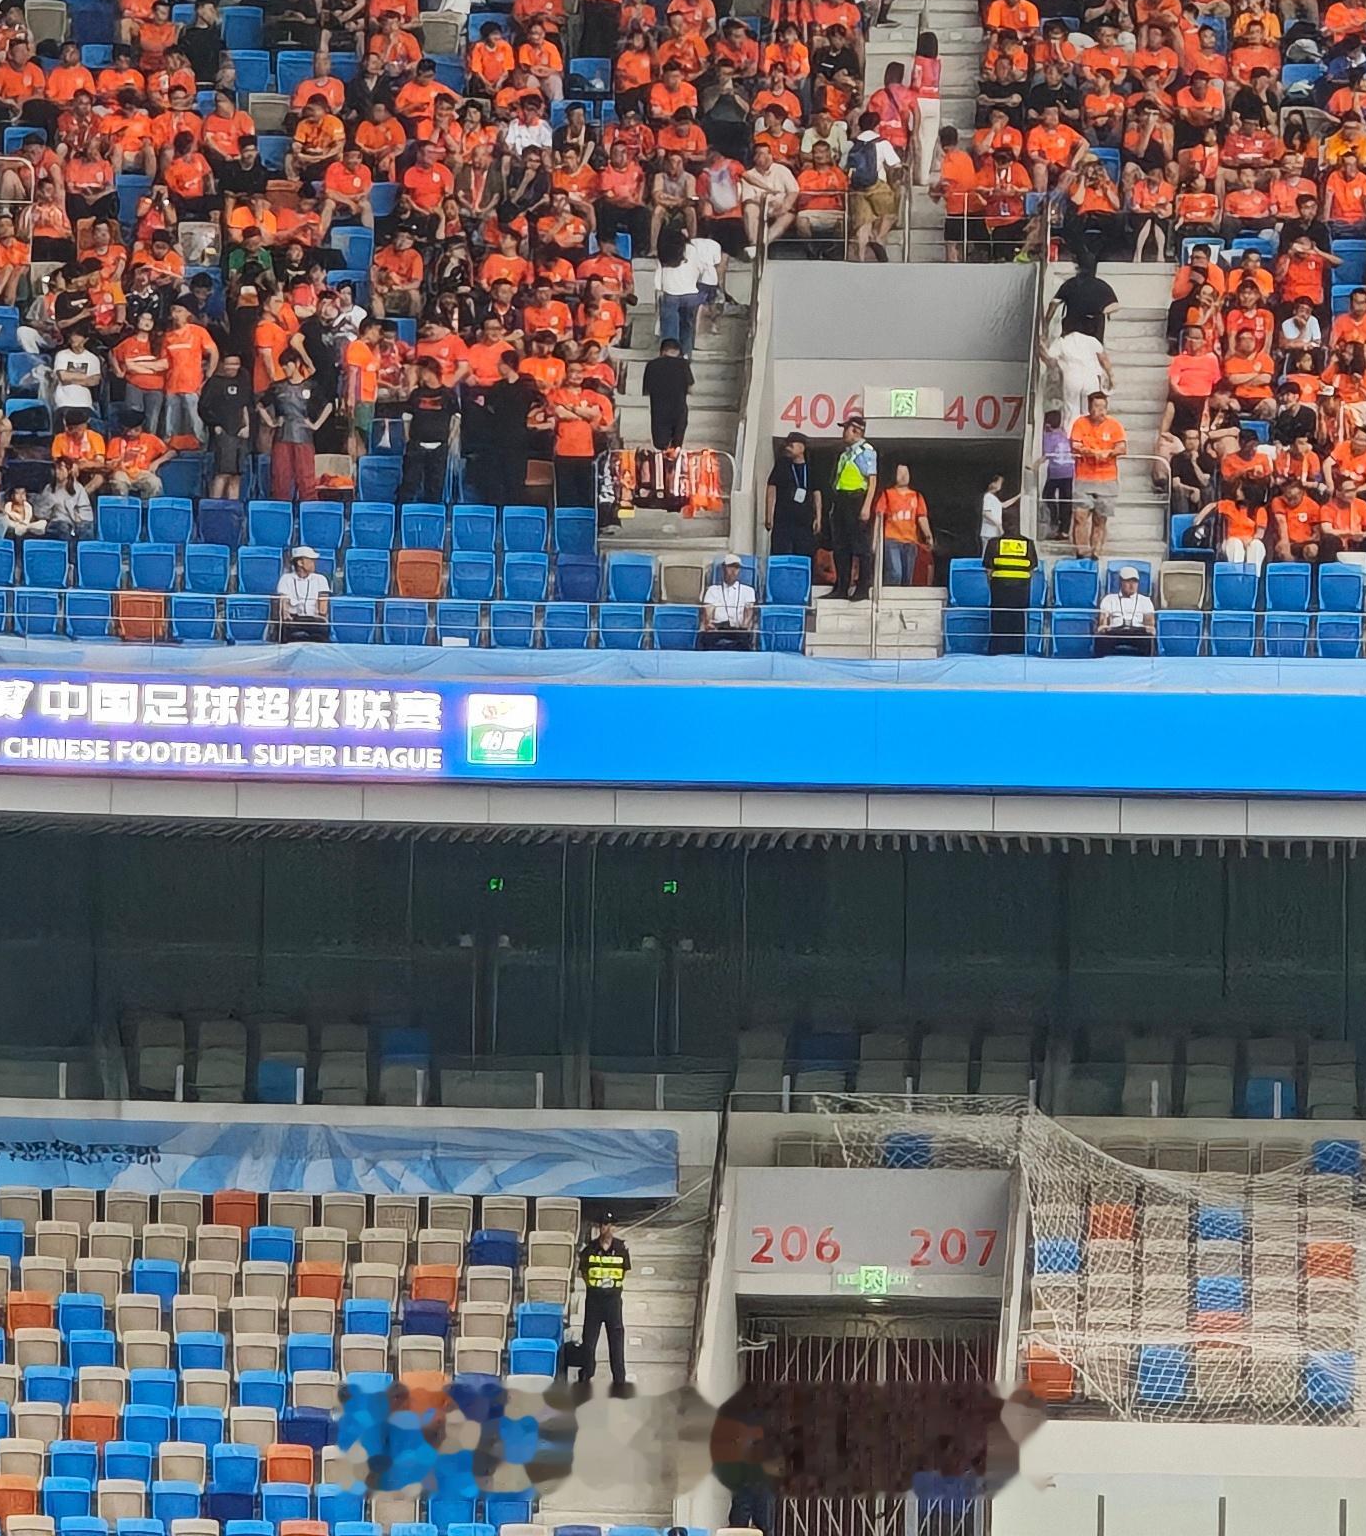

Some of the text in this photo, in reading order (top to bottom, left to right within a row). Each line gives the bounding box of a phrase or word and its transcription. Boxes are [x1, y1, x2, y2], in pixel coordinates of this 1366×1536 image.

[943, 395, 1024, 432] 407
[39, 681, 443, 731] 中国足球超级联赛
[3, 737, 110, 762] CHINESE
[115, 740, 249, 765] FOOTBALL
[253, 744, 336, 767] SUPER
[342, 746, 442, 769] LEAGUE
[751, 1226, 998, 1267] 206 207
